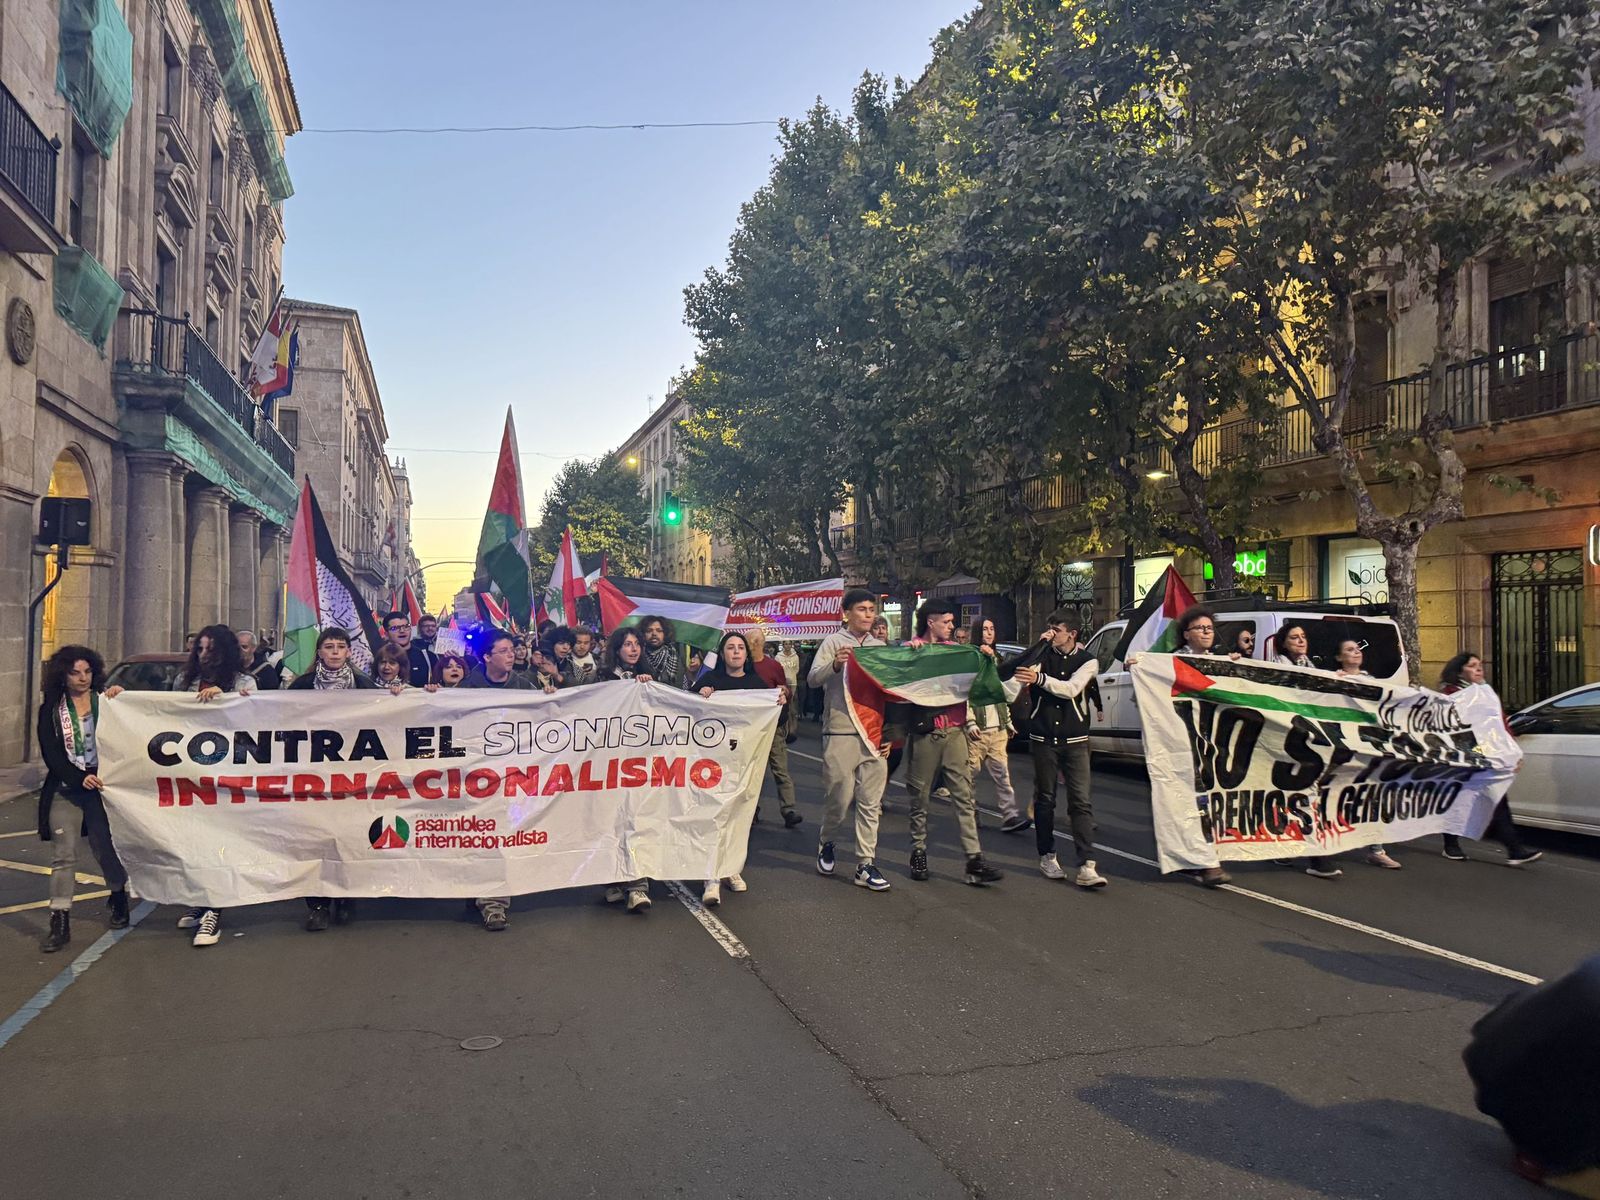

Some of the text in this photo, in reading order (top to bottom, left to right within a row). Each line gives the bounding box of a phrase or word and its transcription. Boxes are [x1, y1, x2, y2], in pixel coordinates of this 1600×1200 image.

[764, 599, 782, 615] DEL
[786, 596, 842, 615] SIONISMO!
[58, 700, 74, 750] PALESTIN
[147, 714, 738, 767] CONTRA EL SIONISMO,
[156, 756, 723, 807] INTERNACIONALISMO
[1341, 780, 1463, 825] GENOCIDIO
[415, 815, 496, 832] asamblea
[415, 830, 548, 849] internacionalista
